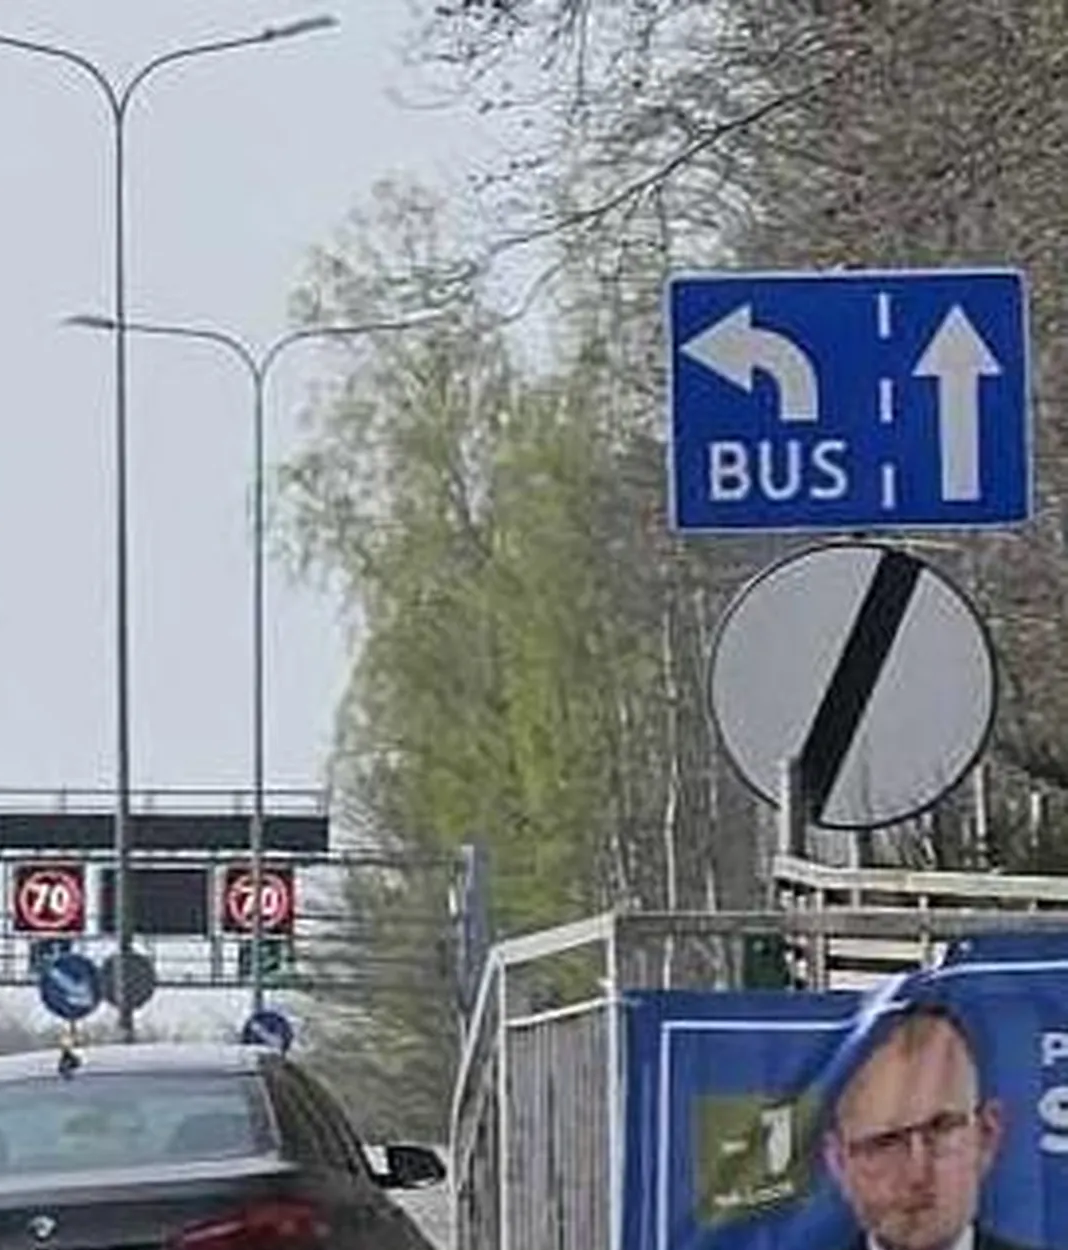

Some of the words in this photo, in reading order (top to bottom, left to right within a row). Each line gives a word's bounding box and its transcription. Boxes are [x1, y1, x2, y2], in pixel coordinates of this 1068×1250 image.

[708, 439, 849, 501] BUS
[30, 883, 71, 914] 70
[241, 884, 280, 914] 70
